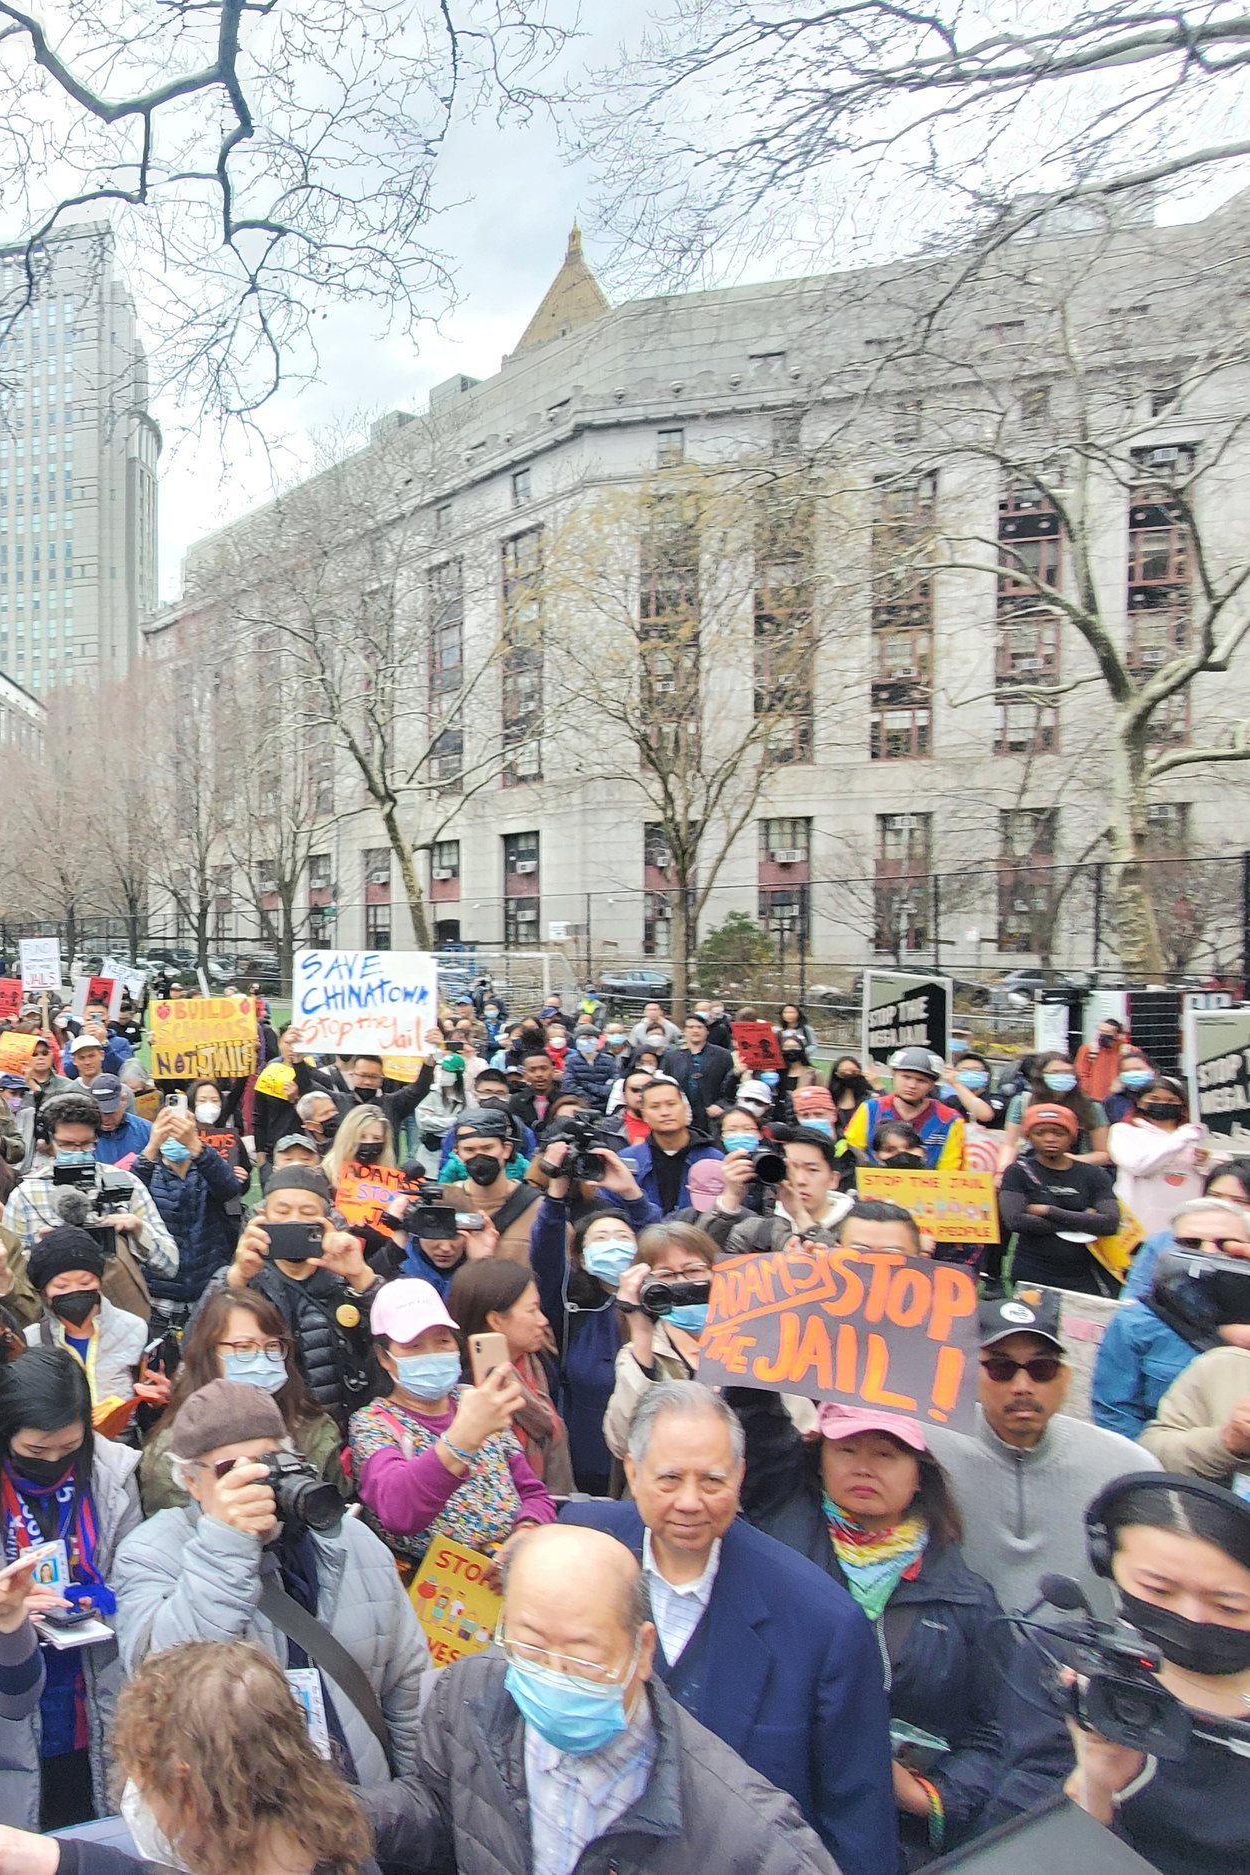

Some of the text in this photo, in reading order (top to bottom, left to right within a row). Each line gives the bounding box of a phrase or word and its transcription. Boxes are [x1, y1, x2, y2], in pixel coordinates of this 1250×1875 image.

[302, 953, 383, 980] SAVE
[175, 1000, 236, 1020] BUILD
[869, 996, 929, 1028] STOP THE
[156, 1018, 250, 1044] SCHOOLS
[156, 1051, 196, 1075] NOT
[1197, 1054, 1243, 1088] STOP
[864, 1174, 987, 1189] STOP THE JAIL
[938, 1226, 992, 1237] PEOPLE
[820, 1249, 977, 1342] STOP
[699, 1312, 966, 1423] THE JAIL!
